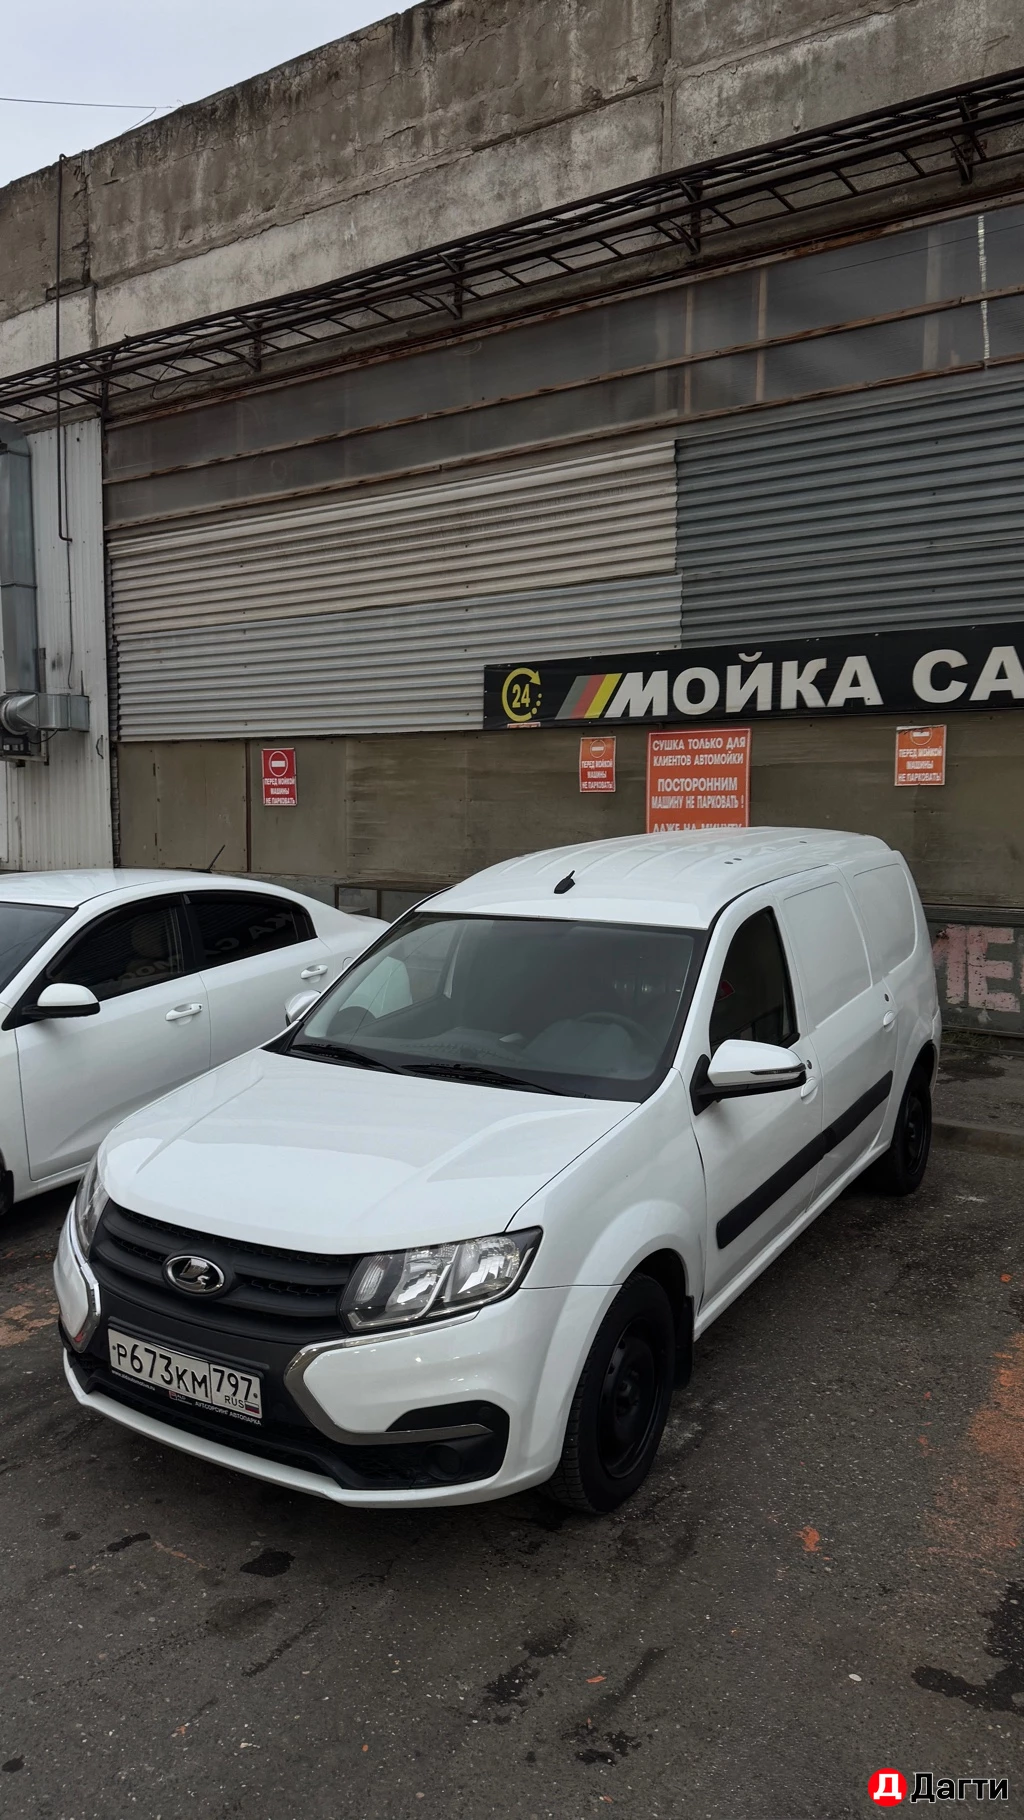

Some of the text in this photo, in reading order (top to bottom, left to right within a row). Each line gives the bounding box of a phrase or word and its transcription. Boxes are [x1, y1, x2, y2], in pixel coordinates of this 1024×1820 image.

[604, 651, 884, 718] МОЙКА
[512, 683, 531, 708] 24
[652, 736, 746, 751] СУШКА ТОЛЬКО ДЛЯ
[653, 751, 744, 767] КЛИЕНТОВ АВТОМОЙКИ
[657, 777, 738, 792] ПОСТОРОННИМ
[651, 796, 684, 809] МАШИНУ
[685, 795, 695, 809] НЕ
[697, 795, 739, 809] ПАРКОВАТЬ
[224, 1394, 245, 1409] RUS
